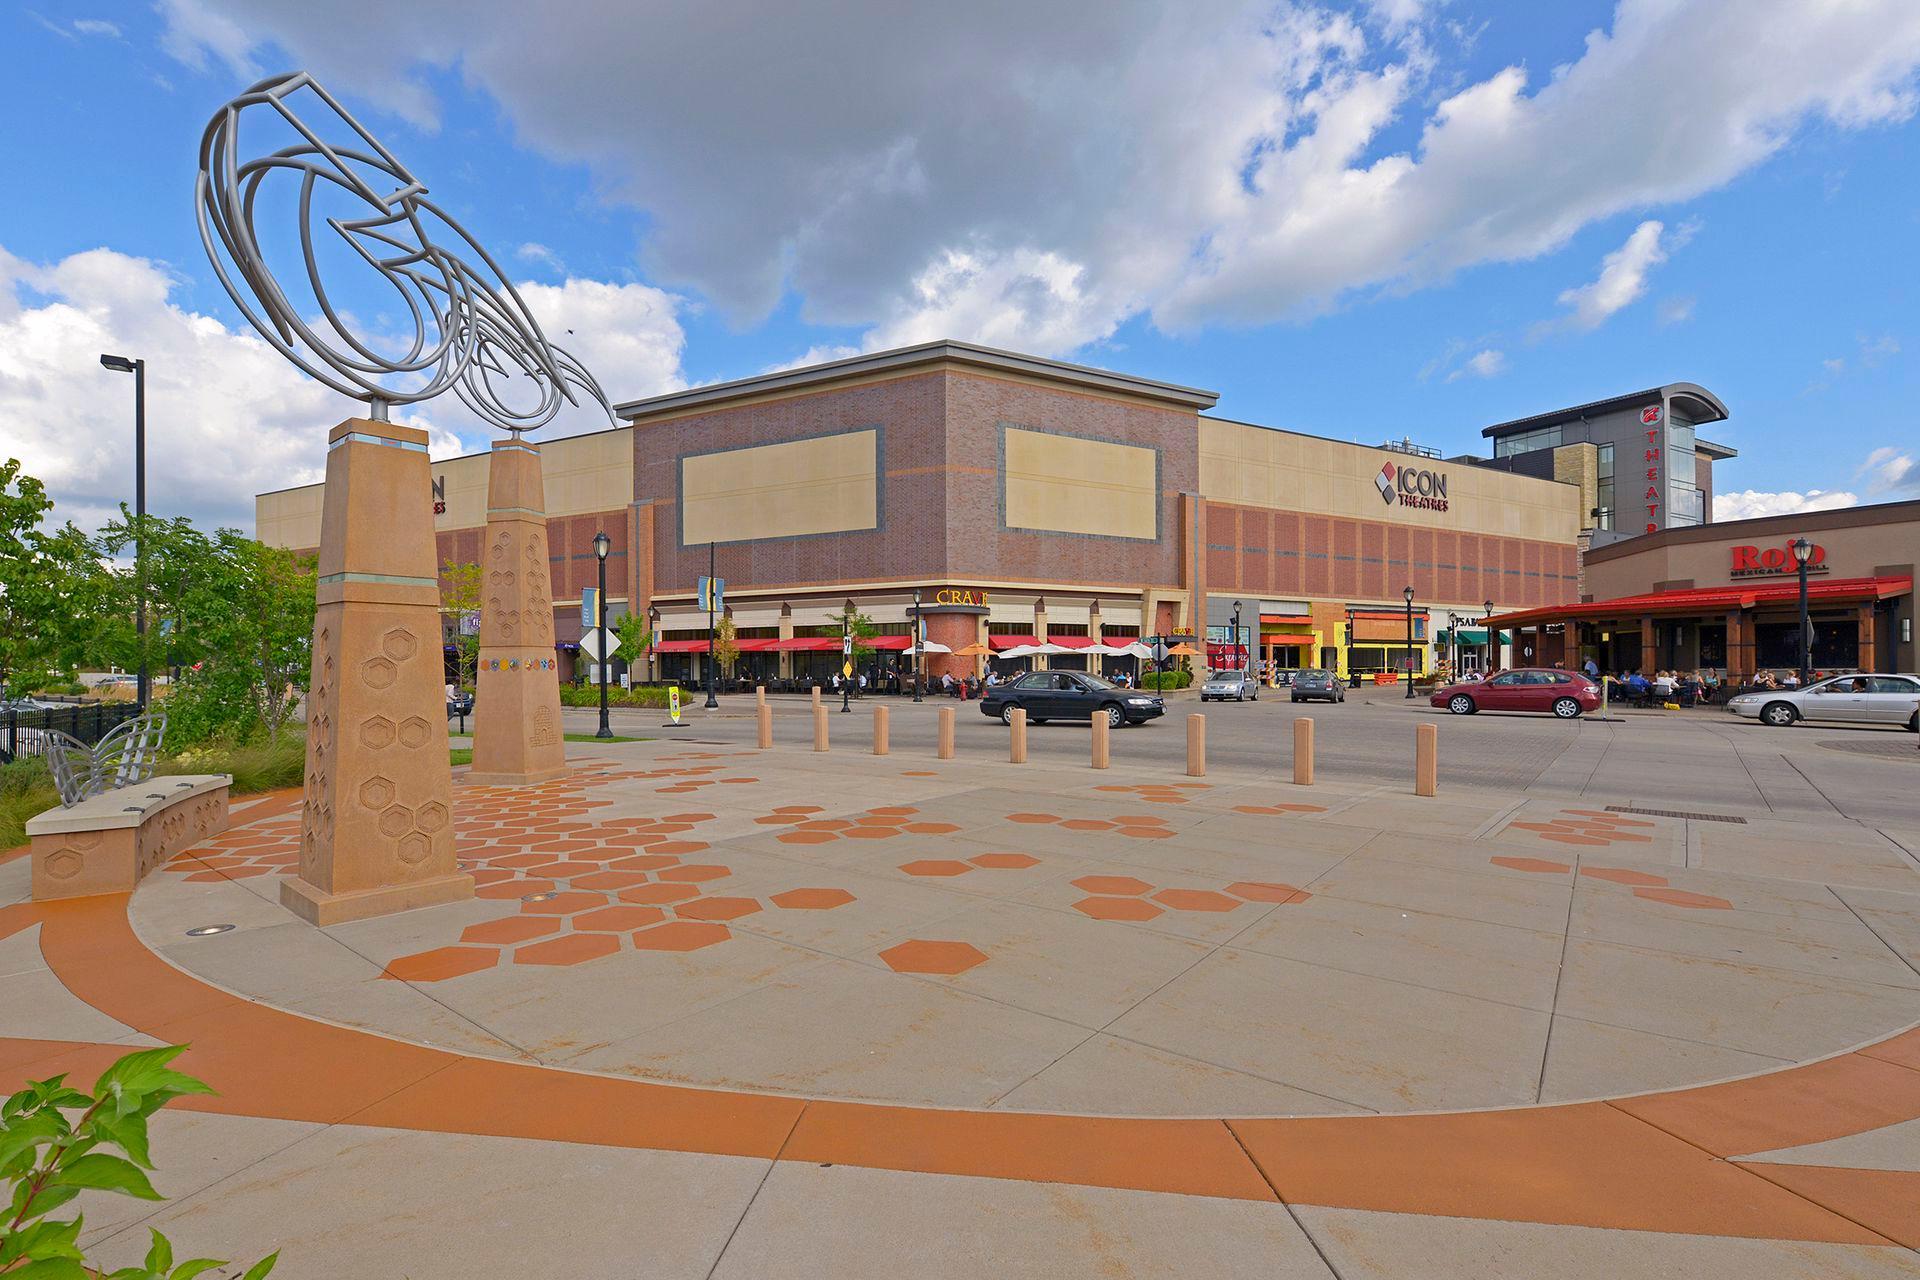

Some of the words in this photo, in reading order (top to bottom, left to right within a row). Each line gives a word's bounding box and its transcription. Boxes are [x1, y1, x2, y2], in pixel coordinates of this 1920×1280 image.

[1397, 465, 1447, 498] ICON
[1645, 430, 1660, 534] THEATR
[1398, 493, 1449, 512] THEATRES
